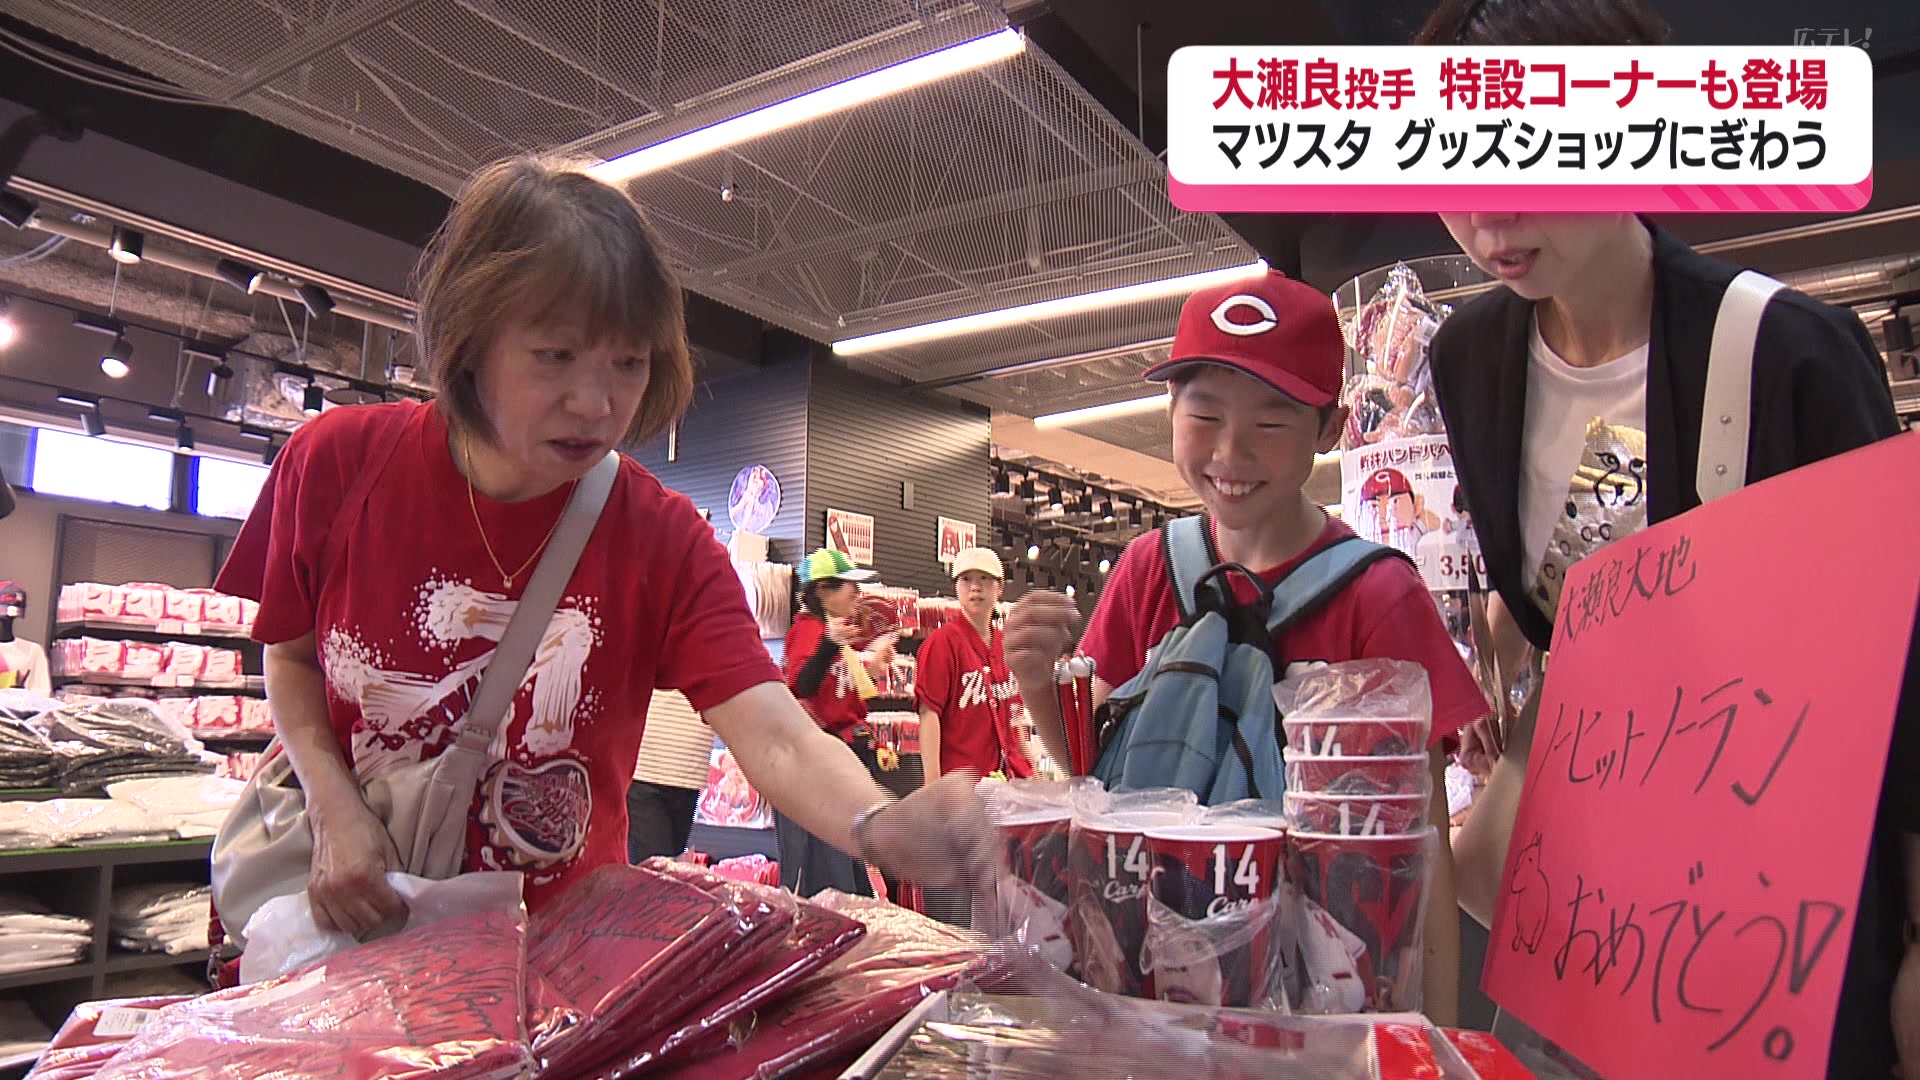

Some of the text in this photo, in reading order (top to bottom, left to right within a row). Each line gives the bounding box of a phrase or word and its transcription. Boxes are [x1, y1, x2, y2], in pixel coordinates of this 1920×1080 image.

[1210, 294, 1280, 337] C
[1553, 534, 1697, 657] 大瀬良大地
[1529, 677, 1811, 806] ノーヒットノーラン
[1338, 802, 1385, 836] 14
[1105, 834, 1149, 881] 14
[1212, 843, 1260, 895] 14
